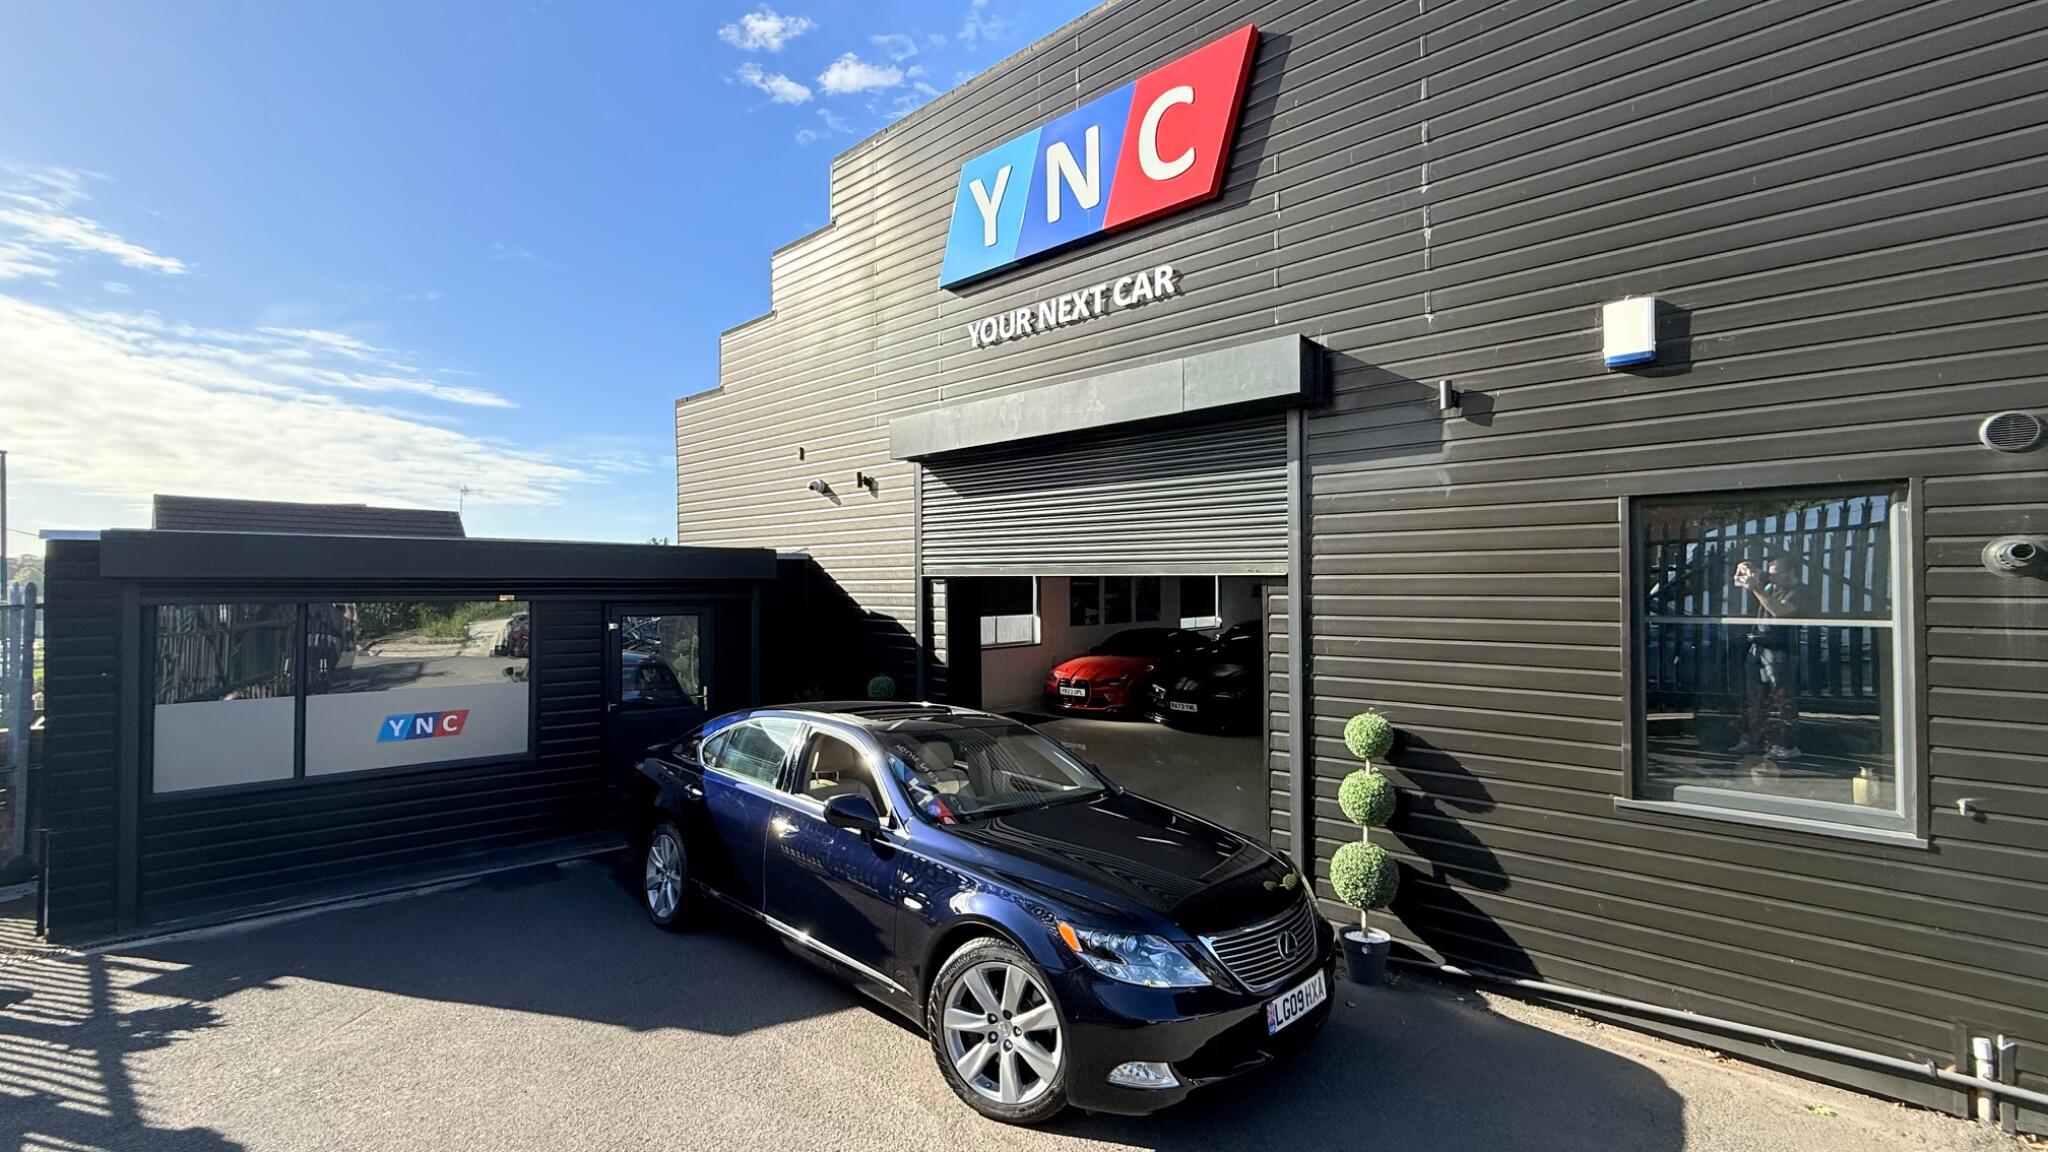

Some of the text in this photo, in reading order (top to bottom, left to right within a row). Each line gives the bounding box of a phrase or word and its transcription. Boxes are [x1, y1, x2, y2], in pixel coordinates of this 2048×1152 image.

[969, 86, 1196, 247] YNC
[967, 265, 1175, 347] YOUR NEXT CAR
[388, 715, 458, 737] YNC
[1275, 976, 1324, 1026] LG09 HXA
